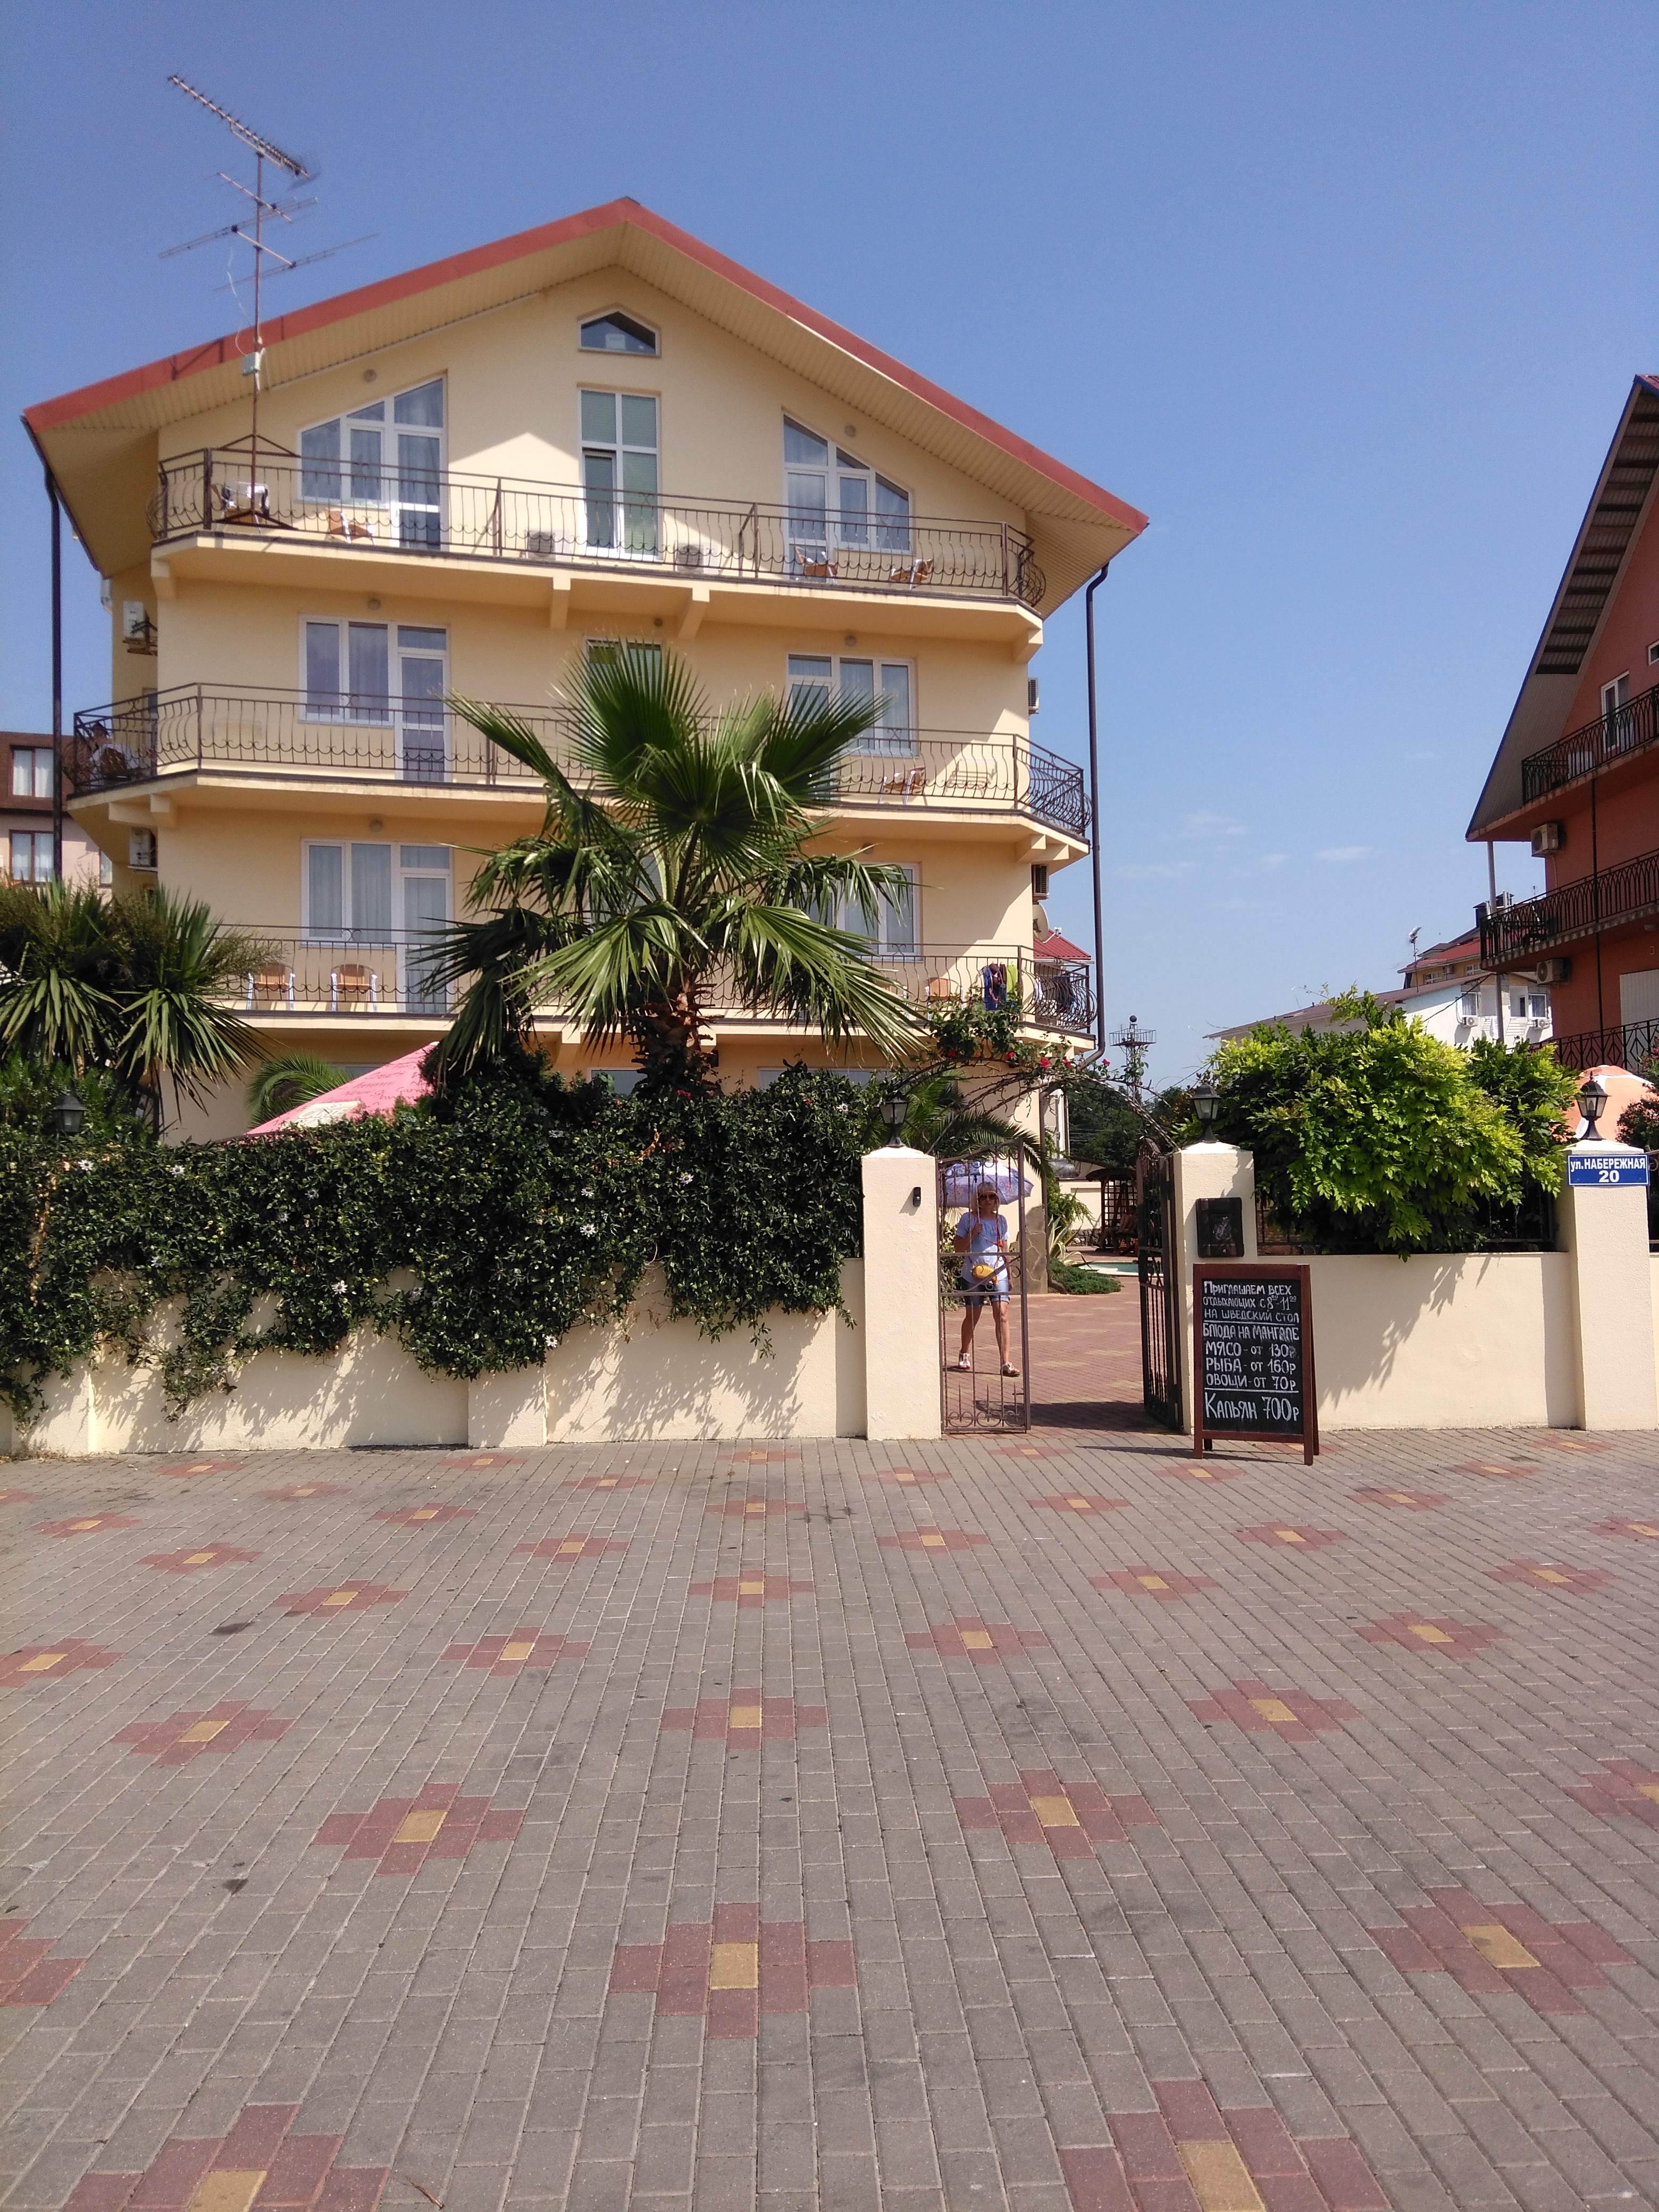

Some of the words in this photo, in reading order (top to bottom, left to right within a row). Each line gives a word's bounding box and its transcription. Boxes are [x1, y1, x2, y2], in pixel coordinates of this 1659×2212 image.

[1571, 1161, 1583, 1172] ул.
[1585, 1158, 1645, 1169] НАБЕРЕЖНАЯ
[1599, 1170, 1619, 1183] 20
[1204, 1309, 1217, 1318] НА
[1221, 1310, 1272, 1321] ШВЕДСКИЙ
[1276, 1312, 1300, 1323] СТОЛ
[1203, 1323, 1236, 1339] БЛЮДА
[1238, 1328, 1251, 1339] НА
[1205, 1342, 1242, 1356] МЯСО
[1205, 1358, 1242, 1372] РЫБА
